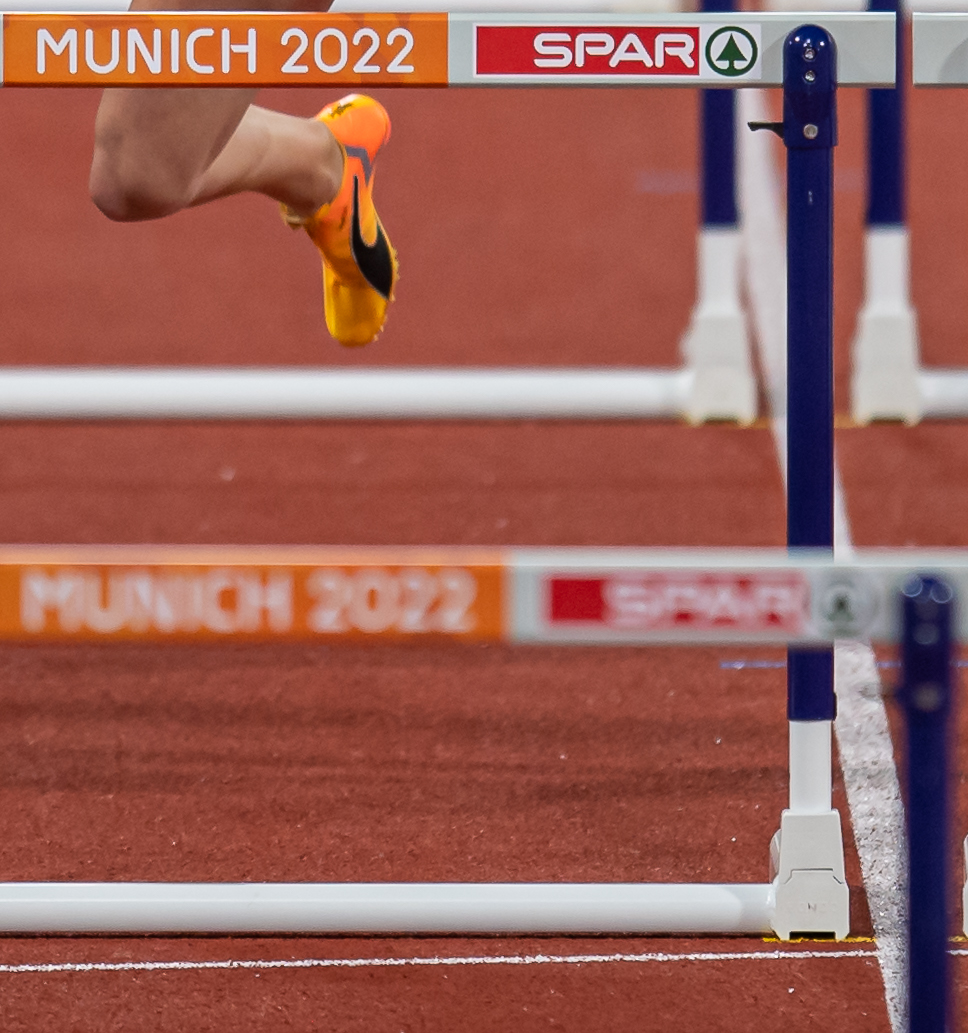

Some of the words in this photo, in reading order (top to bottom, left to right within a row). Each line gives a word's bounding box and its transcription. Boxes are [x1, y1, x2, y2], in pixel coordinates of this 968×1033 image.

[36, 28, 257, 75] MUNICH
[280, 27, 415, 74] 2022
[532, 32, 695, 69] SPAR
[19, 569, 294, 634] MUNICH
[307, 567, 477, 634] 2022
[605, 579, 802, 633] SPAR
